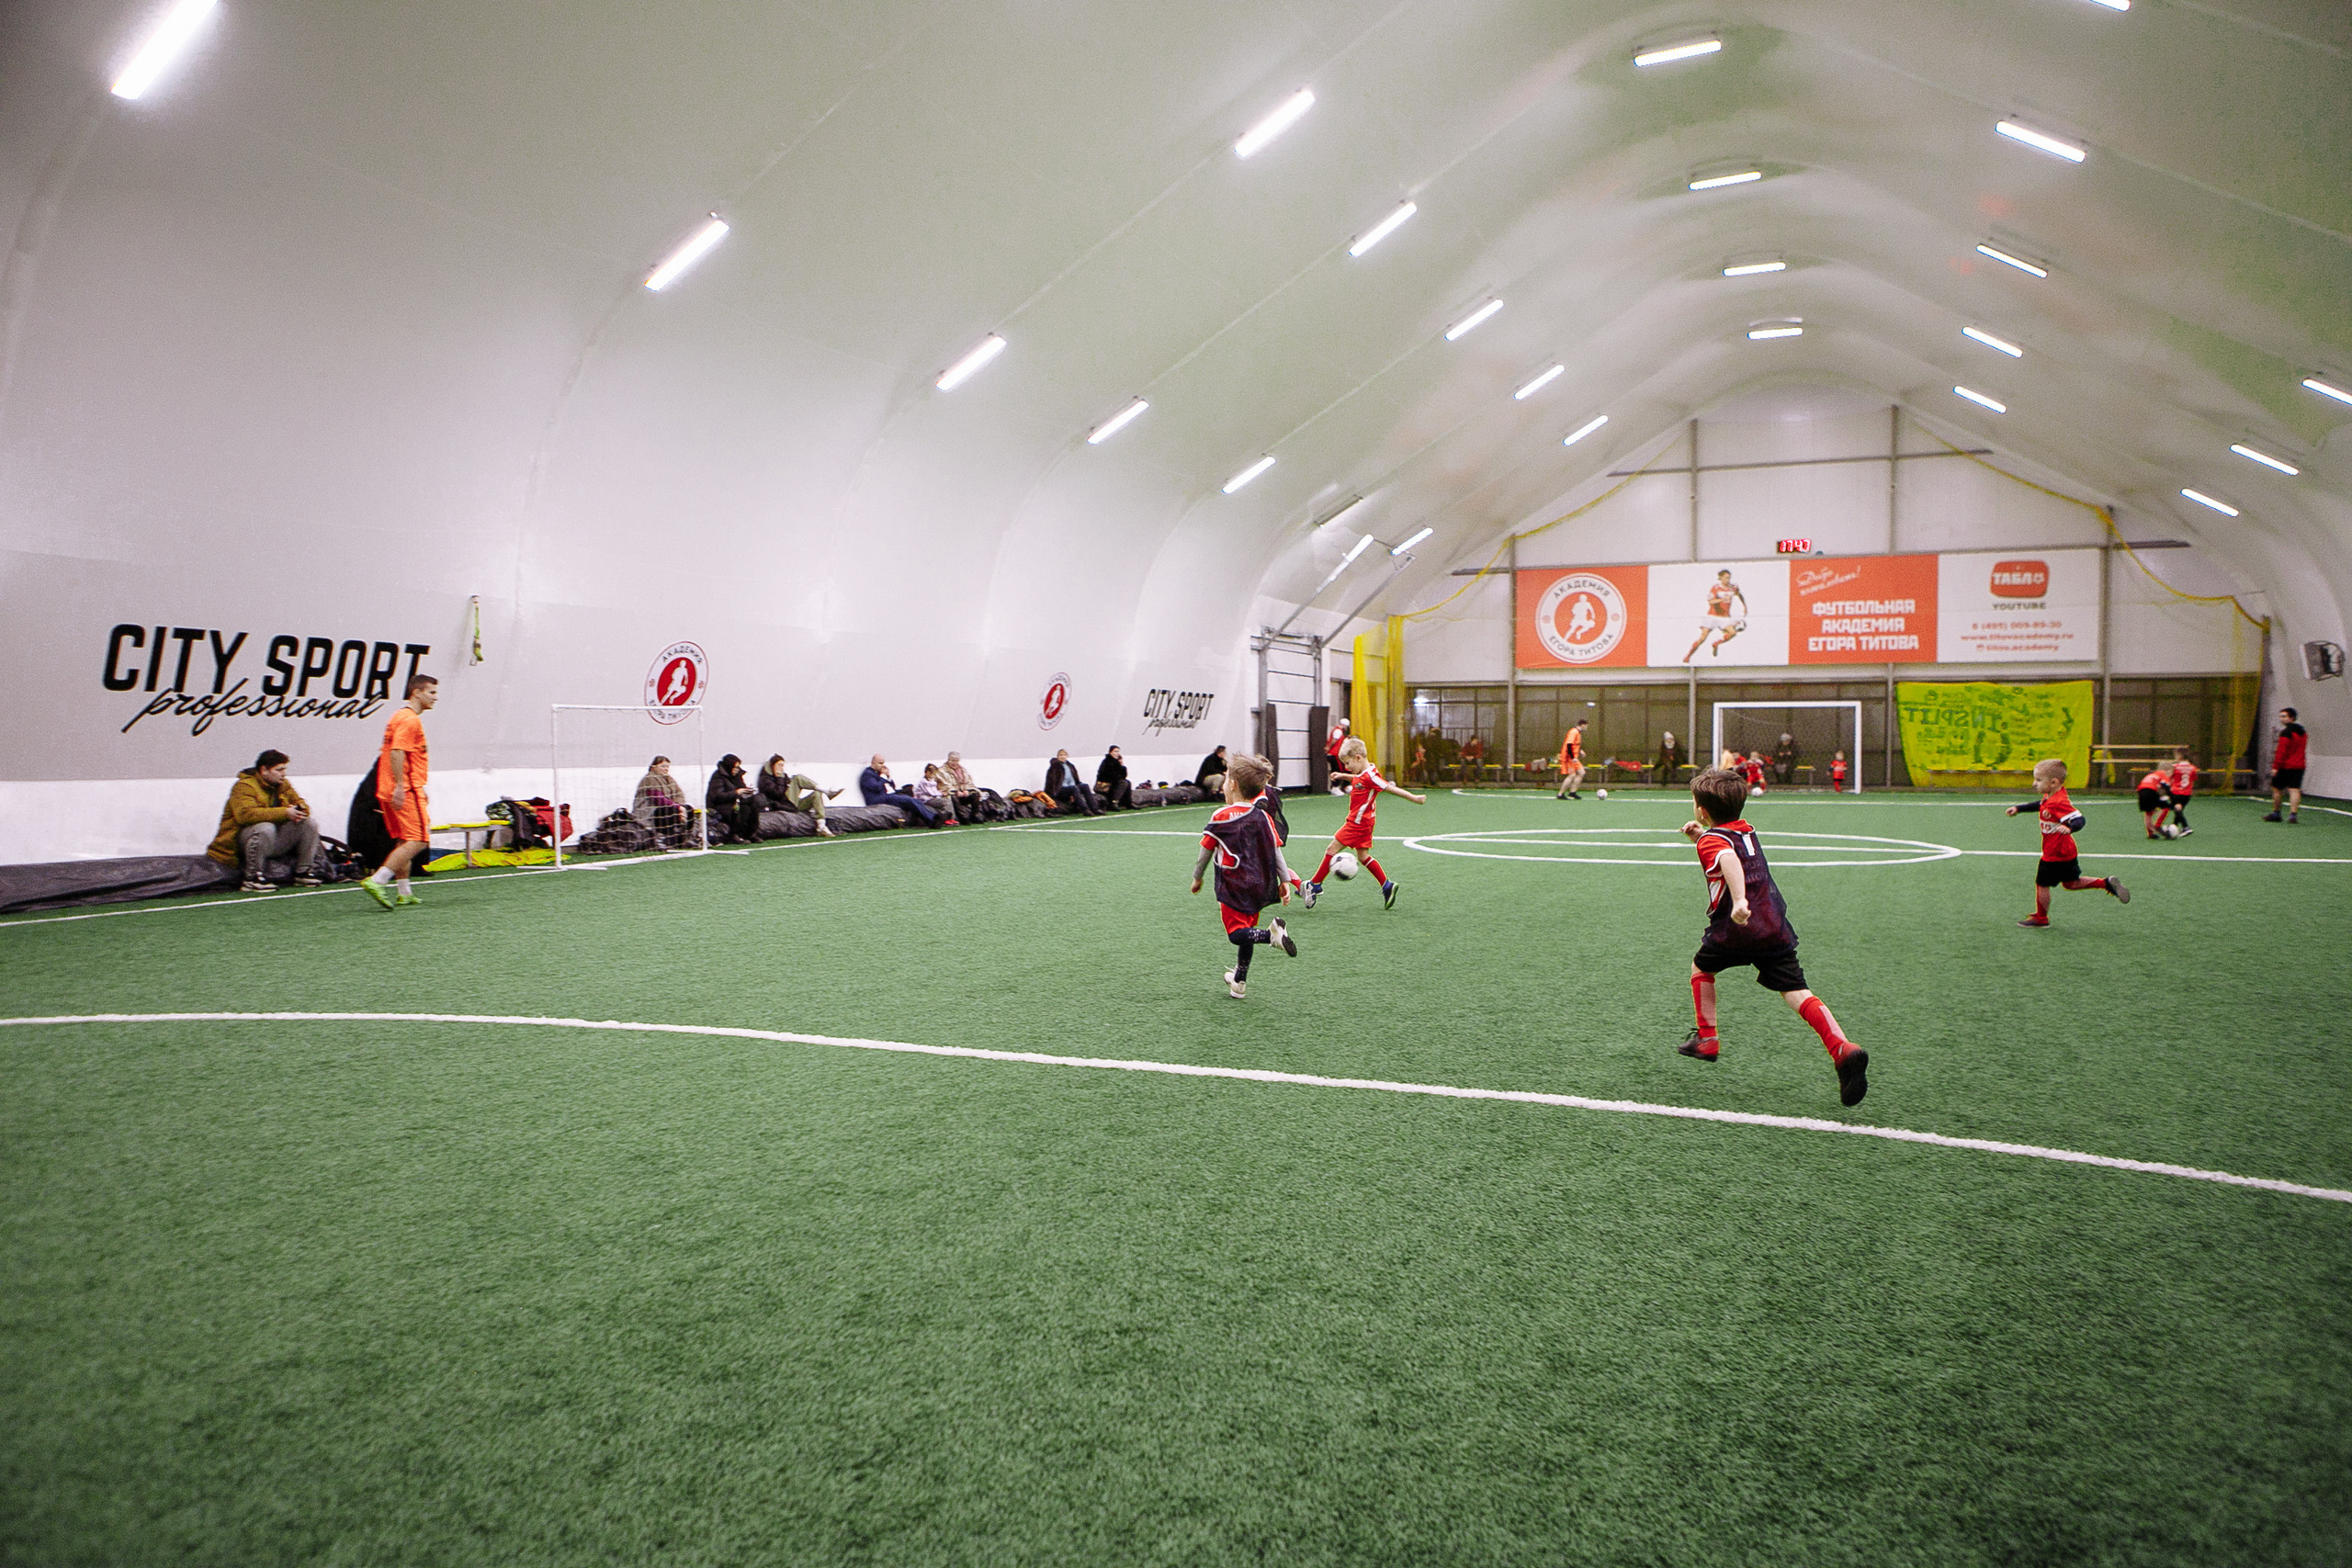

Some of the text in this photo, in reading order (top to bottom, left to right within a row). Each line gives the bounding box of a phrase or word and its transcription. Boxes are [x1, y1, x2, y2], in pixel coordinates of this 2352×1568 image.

[1554, 580, 1611, 599] АКАДЕМИЯ
[1812, 599, 1916, 616] ФУТБОЛЬНАЯ
[1992, 602, 2047, 611] YOUTUBE
[1821, 617, 1905, 634] АКАДЕМИЯ
[1549, 634, 1613, 656] ЕГОРА ТИТОВА
[1808, 635, 1919, 651] ЕГОРА ТИТОВА
[102, 623, 431, 701] CITY SPORT
[121, 678, 385, 737] professional
[1143, 688, 1215, 721] CITY SPORT
